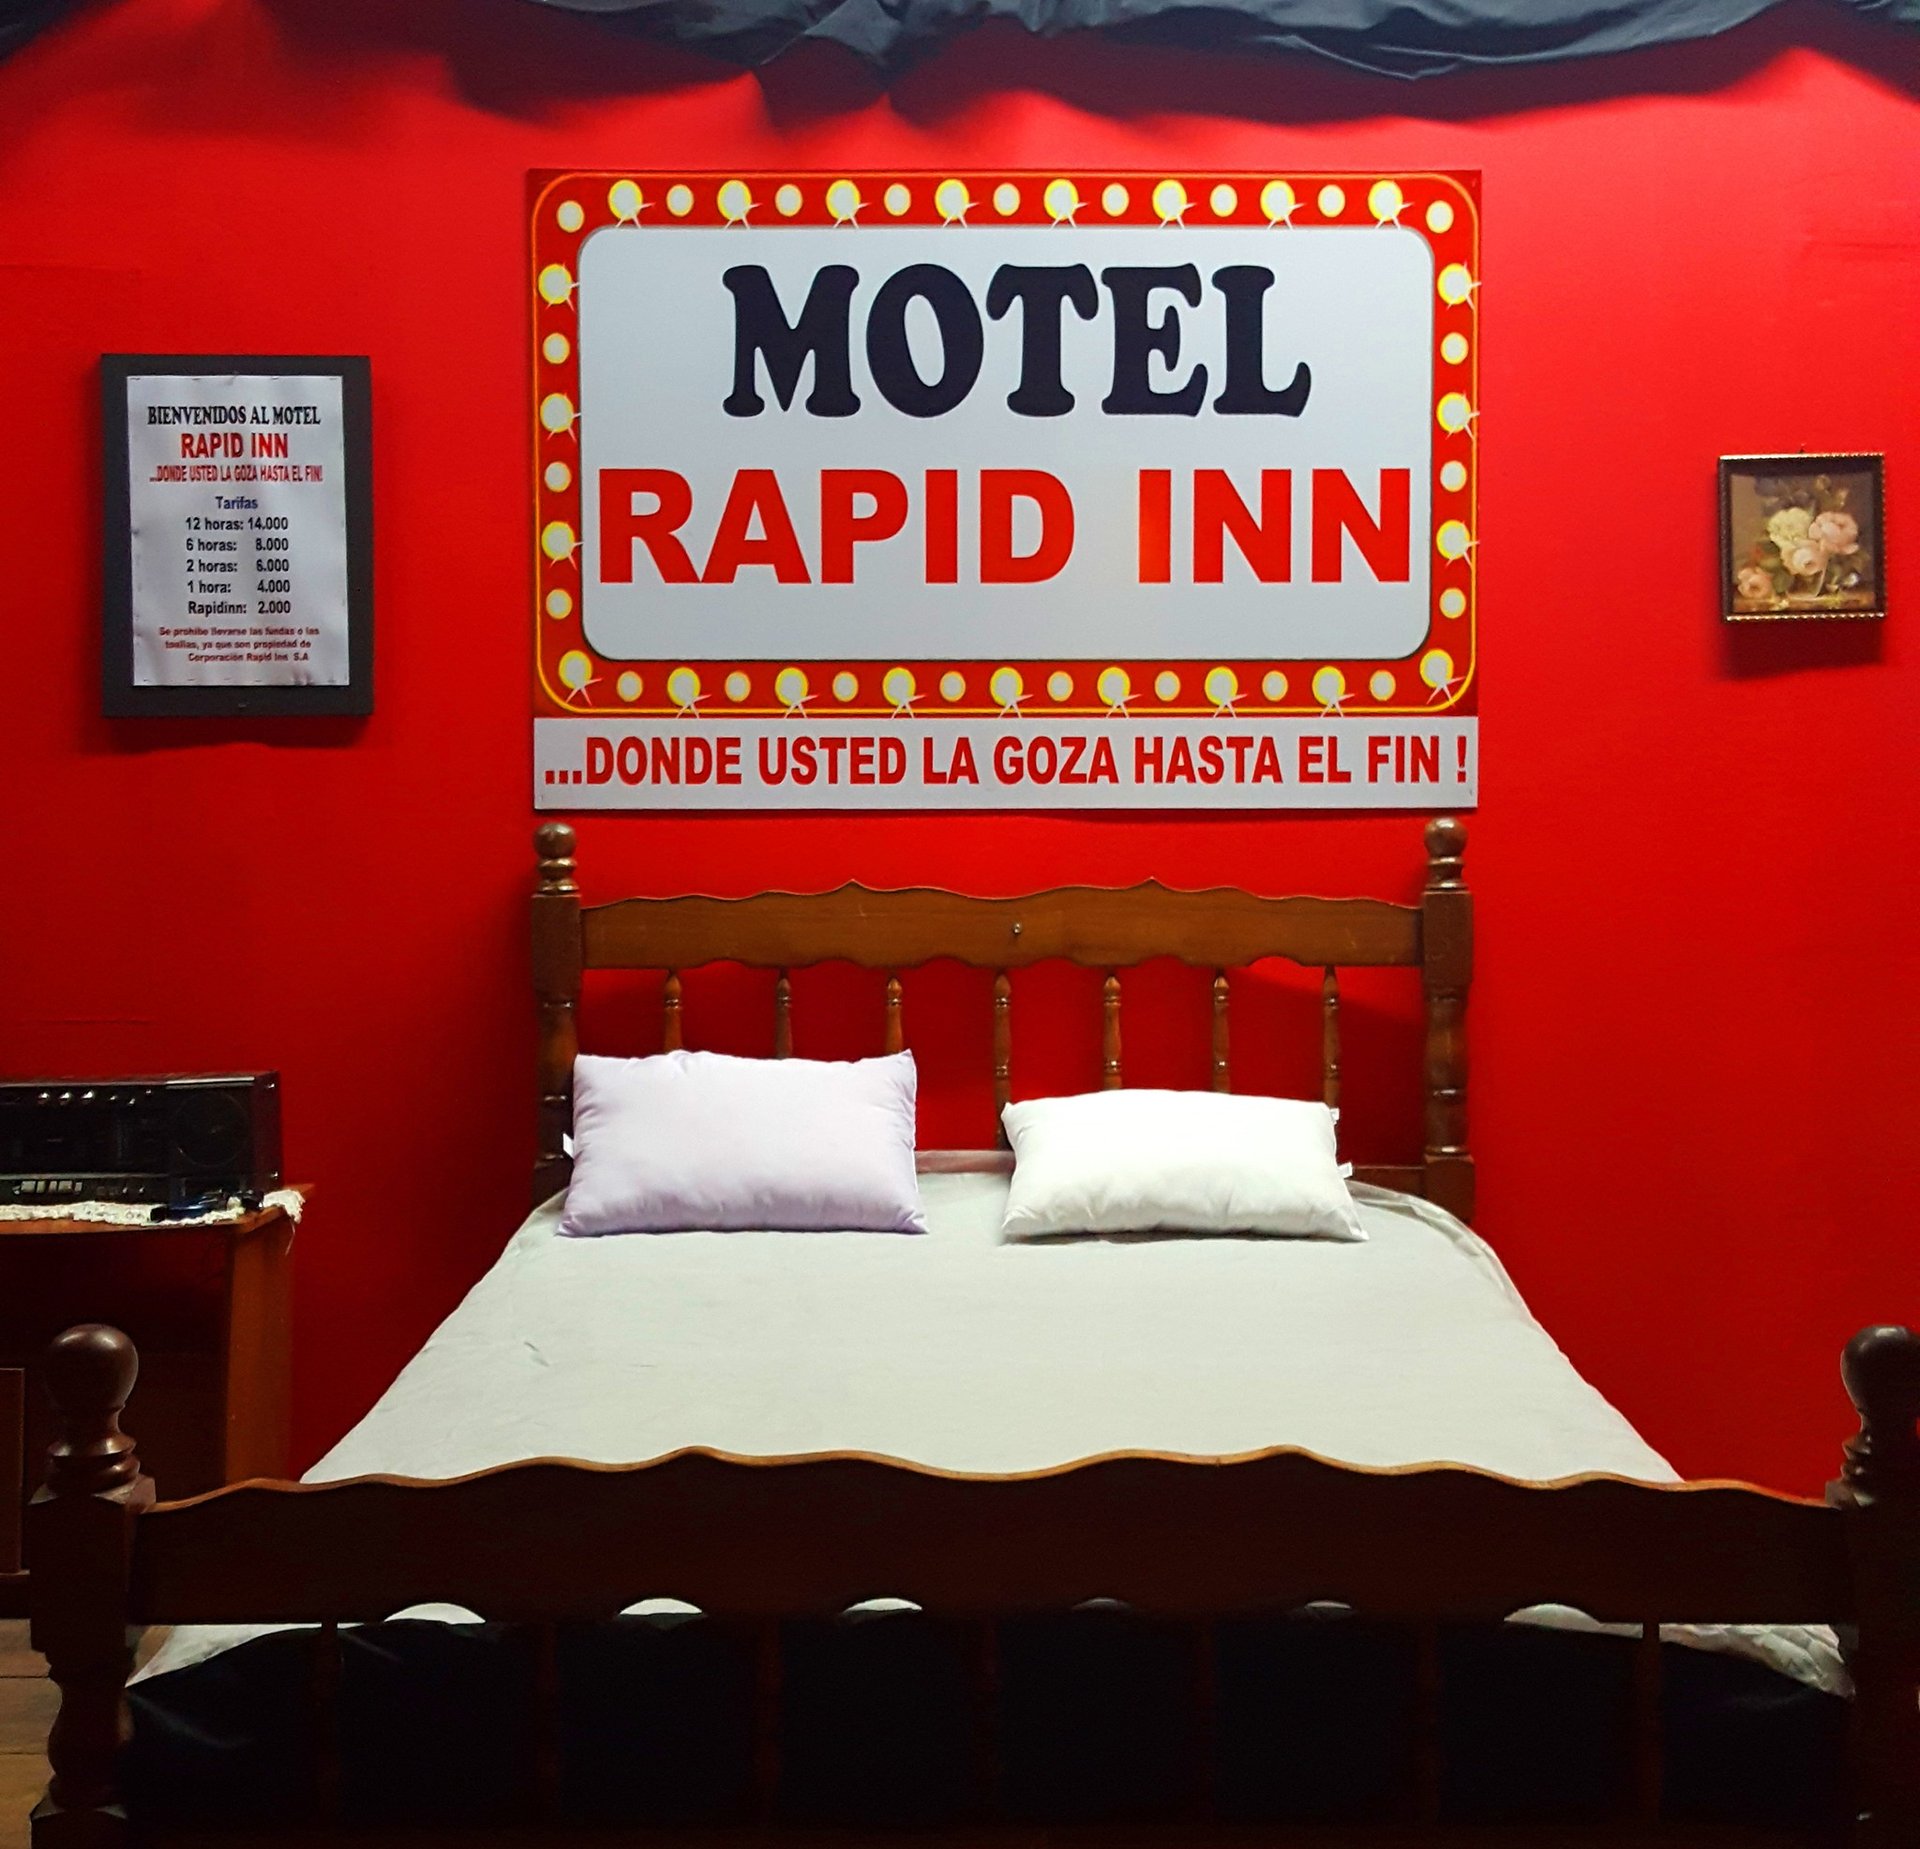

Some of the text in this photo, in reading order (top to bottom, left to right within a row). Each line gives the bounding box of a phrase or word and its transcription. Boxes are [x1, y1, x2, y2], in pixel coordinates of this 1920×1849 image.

[722, 263, 1311, 418] MOTEL
[147, 405, 321, 425] BIENVENIDOS AL MOTEL
[181, 432, 289, 459] RAPID INN
[189, 464, 218, 483] USTED
[220, 464, 232, 483] LA
[234, 464, 258, 483] GOZA
[260, 464, 290, 483] HASTA
[292, 464, 303, 483] EL
[215, 496, 259, 510] Tarifas
[185, 516, 289, 531] 12 horas: 14.000
[599, 468, 1411, 584] RAPID INN
[186, 537, 289, 552] 6 horas: 8.000
[186, 558, 290, 573] 2 horas: 6.000
[187, 579, 291, 594] 1 hora: 4.000
[187, 600, 291, 618] Rapidinn: 2.000
[250, 626, 263, 636] las
[202, 641, 213, 651] ya
[215, 641, 232, 651] que
[234, 641, 250, 649] son
[253, 639, 297, 651] propiedad
[300, 639, 311, 649] de
[246, 651, 272, 663] Rapid
[758, 735, 907, 785] USTED
[923, 735, 980, 785] LA
[993, 735, 1120, 785] GOZA
[1135, 735, 1284, 785] HASTA
[1298, 735, 1352, 785] EL
[1367, 735, 1440, 785] FIN
